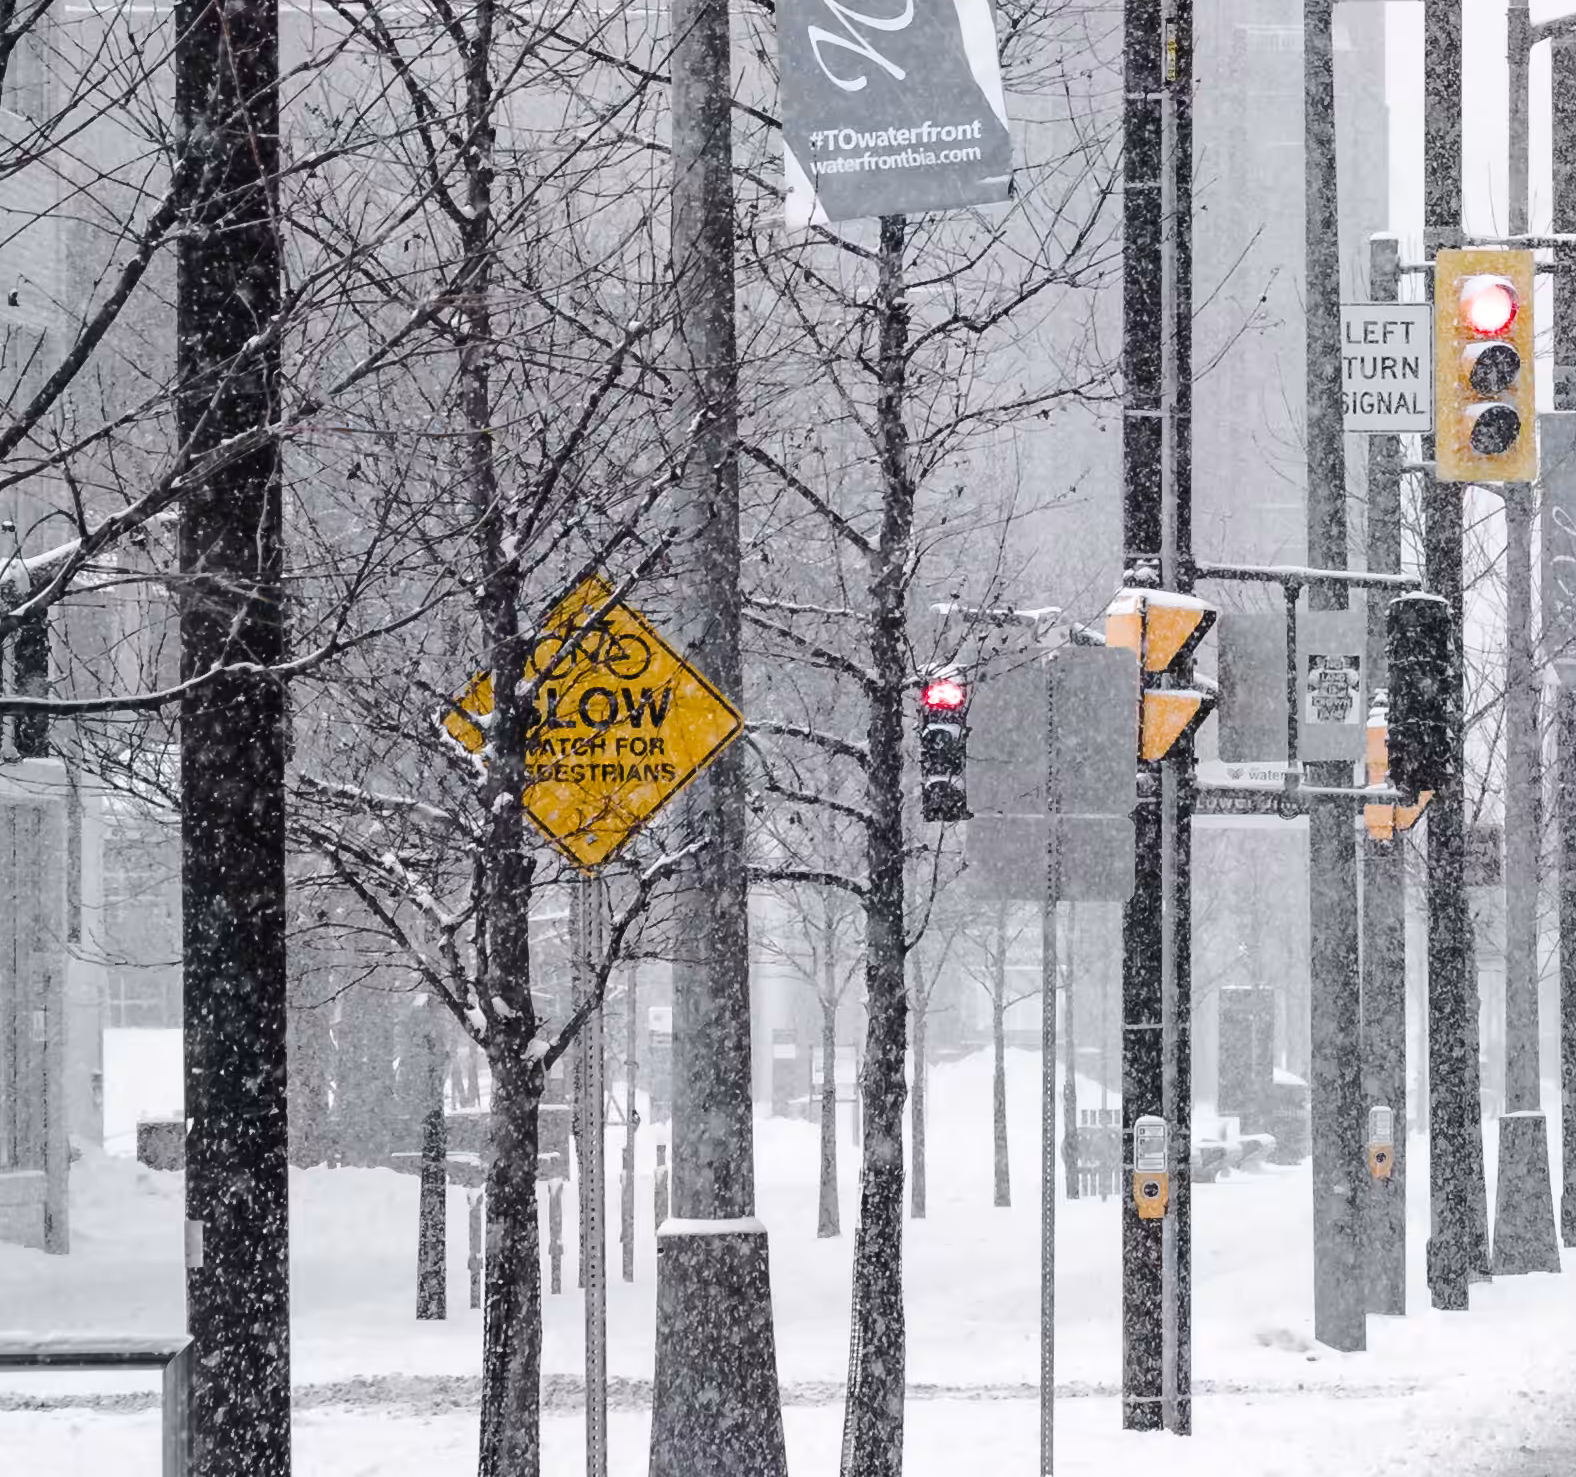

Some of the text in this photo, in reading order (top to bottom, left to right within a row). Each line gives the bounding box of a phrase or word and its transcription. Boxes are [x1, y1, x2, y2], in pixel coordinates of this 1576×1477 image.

[809, 119, 982, 151] #TOwaterfront
[810, 146, 982, 175] waterfrontbia.com
[1346, 320, 1415, 344] LEFT
[1343, 356, 1419, 379] TURN
[1342, 391, 1425, 414] SIGNAL
[616, 737, 665, 756] FOR
[1248, 769, 1287, 781] water
